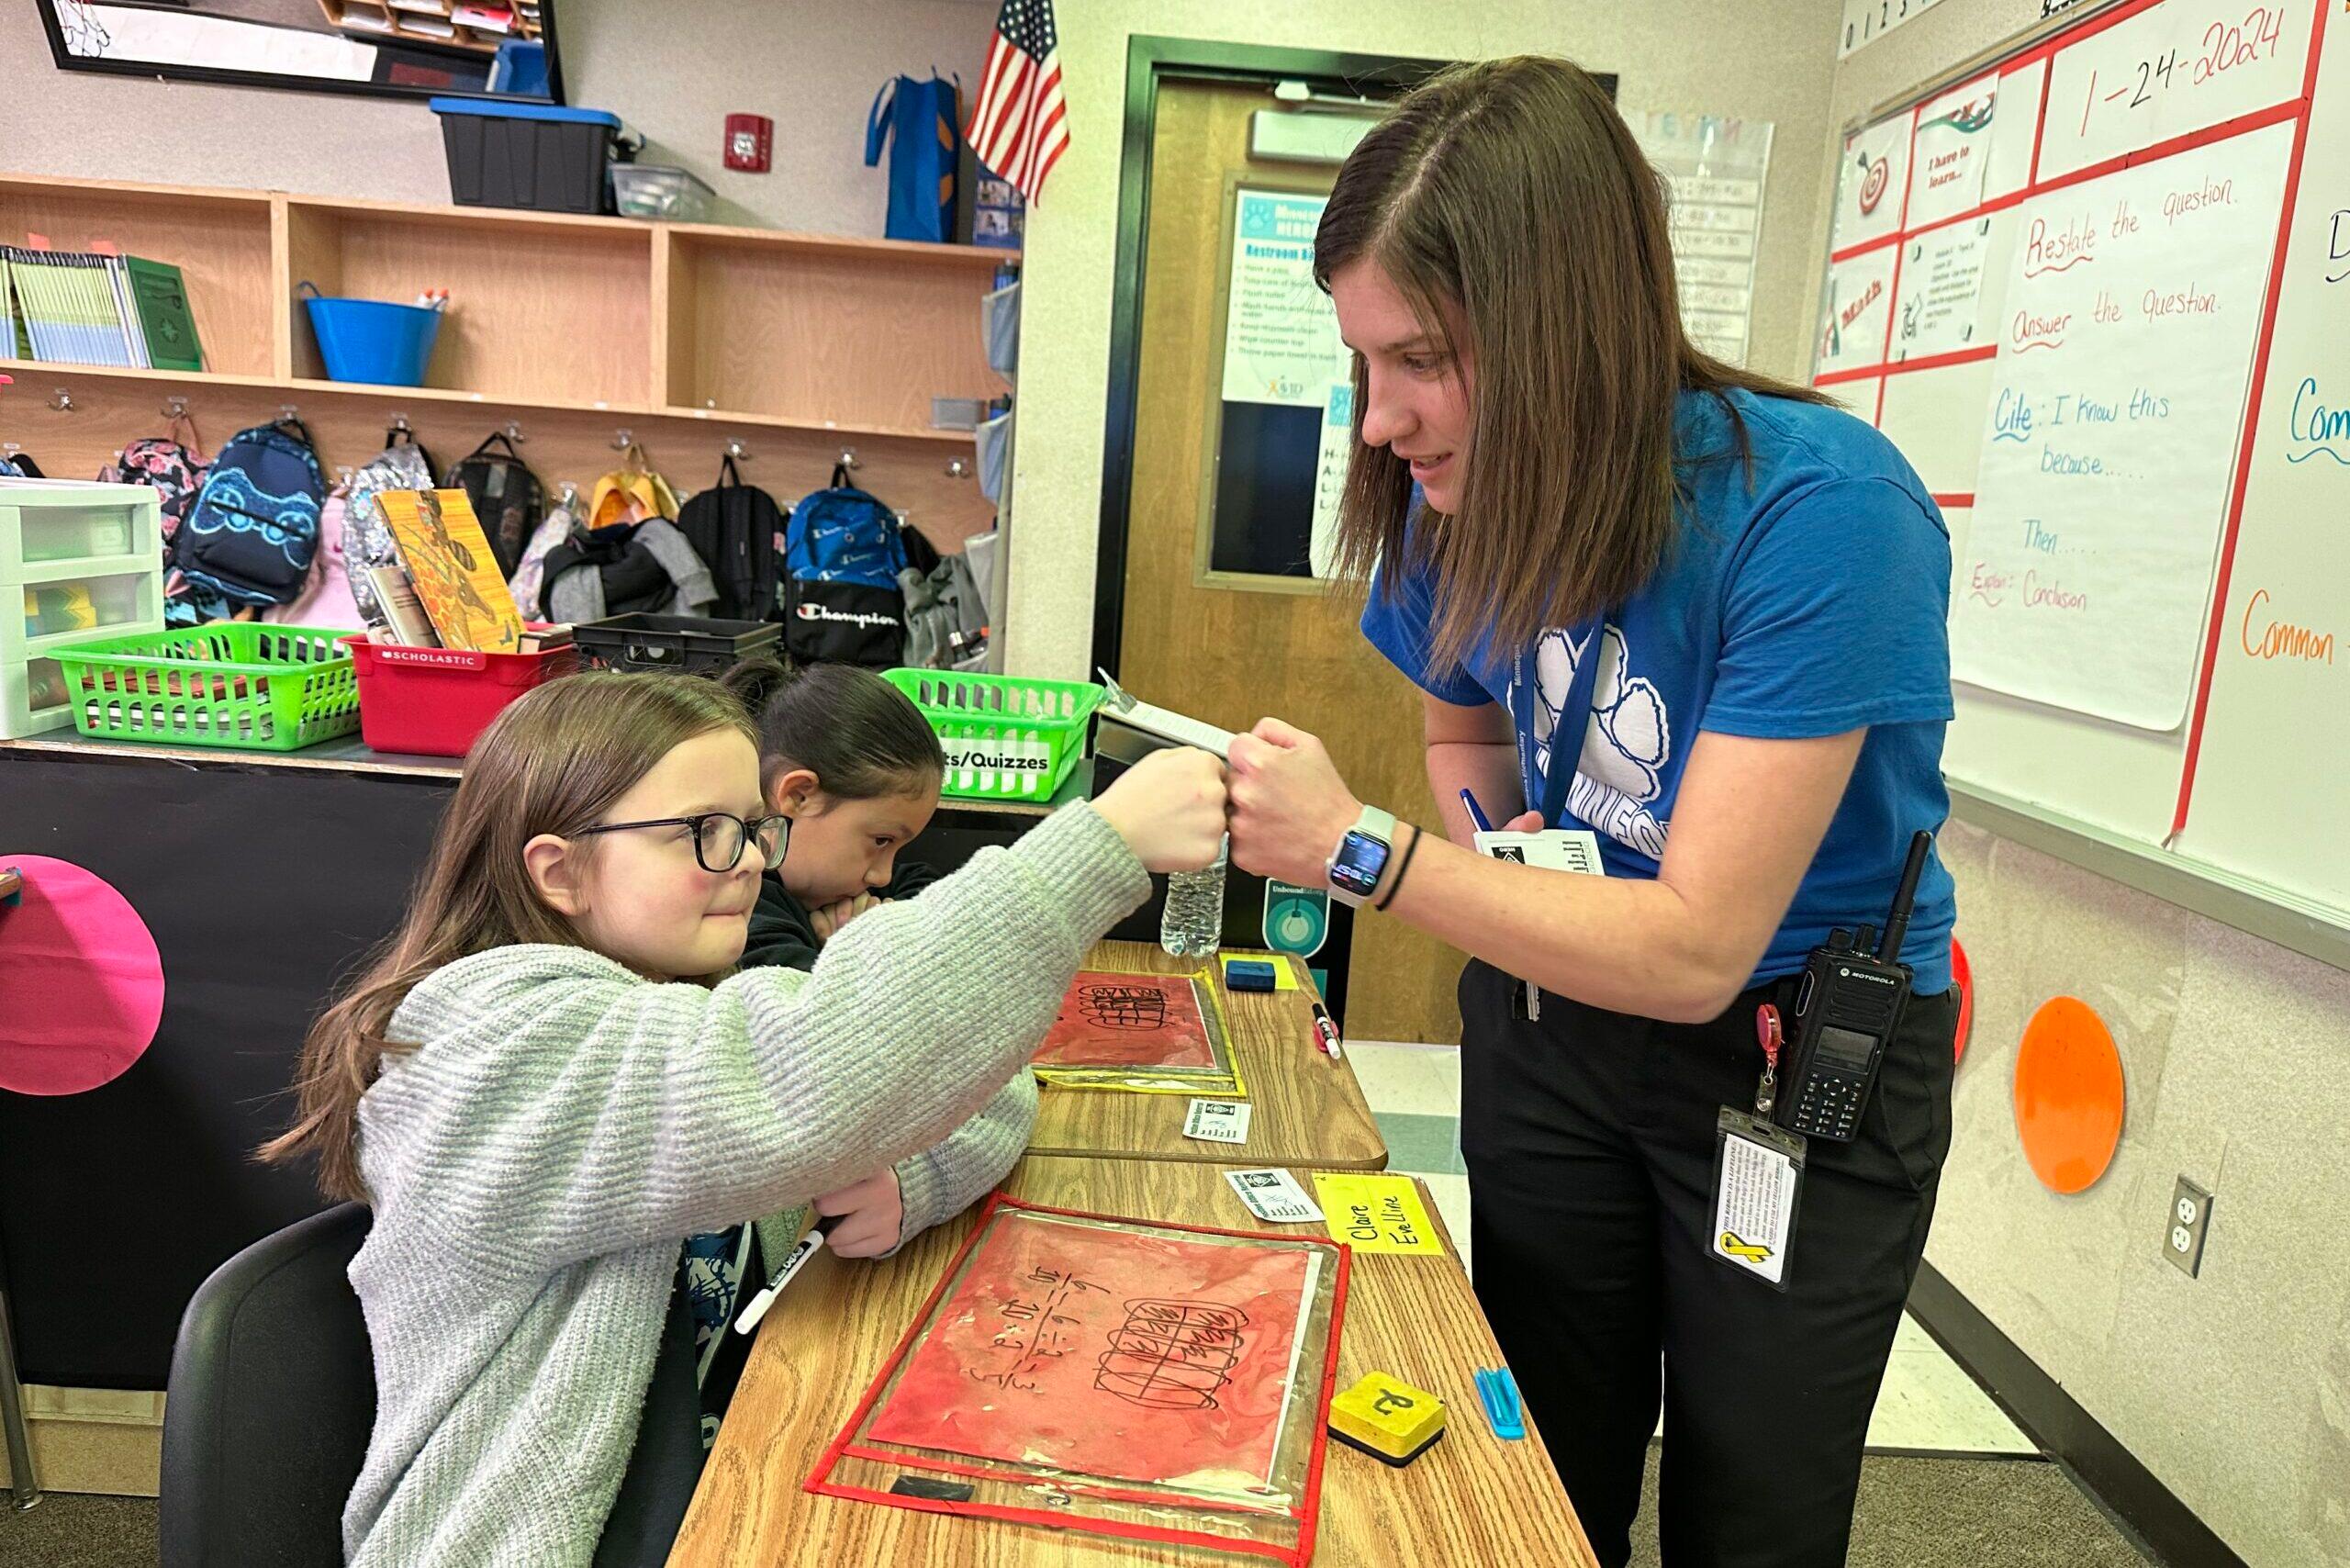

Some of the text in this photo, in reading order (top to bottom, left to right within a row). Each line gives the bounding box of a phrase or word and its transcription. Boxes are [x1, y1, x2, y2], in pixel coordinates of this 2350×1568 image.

[1935, 153, 1957, 168] have
[1960, 146, 1969, 157] to
[2026, 213, 2096, 265] Restate
[2111, 201, 2140, 239] the
[2094, 291, 2122, 324] the
[2130, 387, 2169, 420] this
[797, 602, 900, 630] Champion
[2243, 589, 2333, 665] Common
[392, 651, 475, 666] SCHOLASTIC
[1852, 971, 1896, 986] MOTOROLA
[1347, 1205, 1378, 1240] Claire
